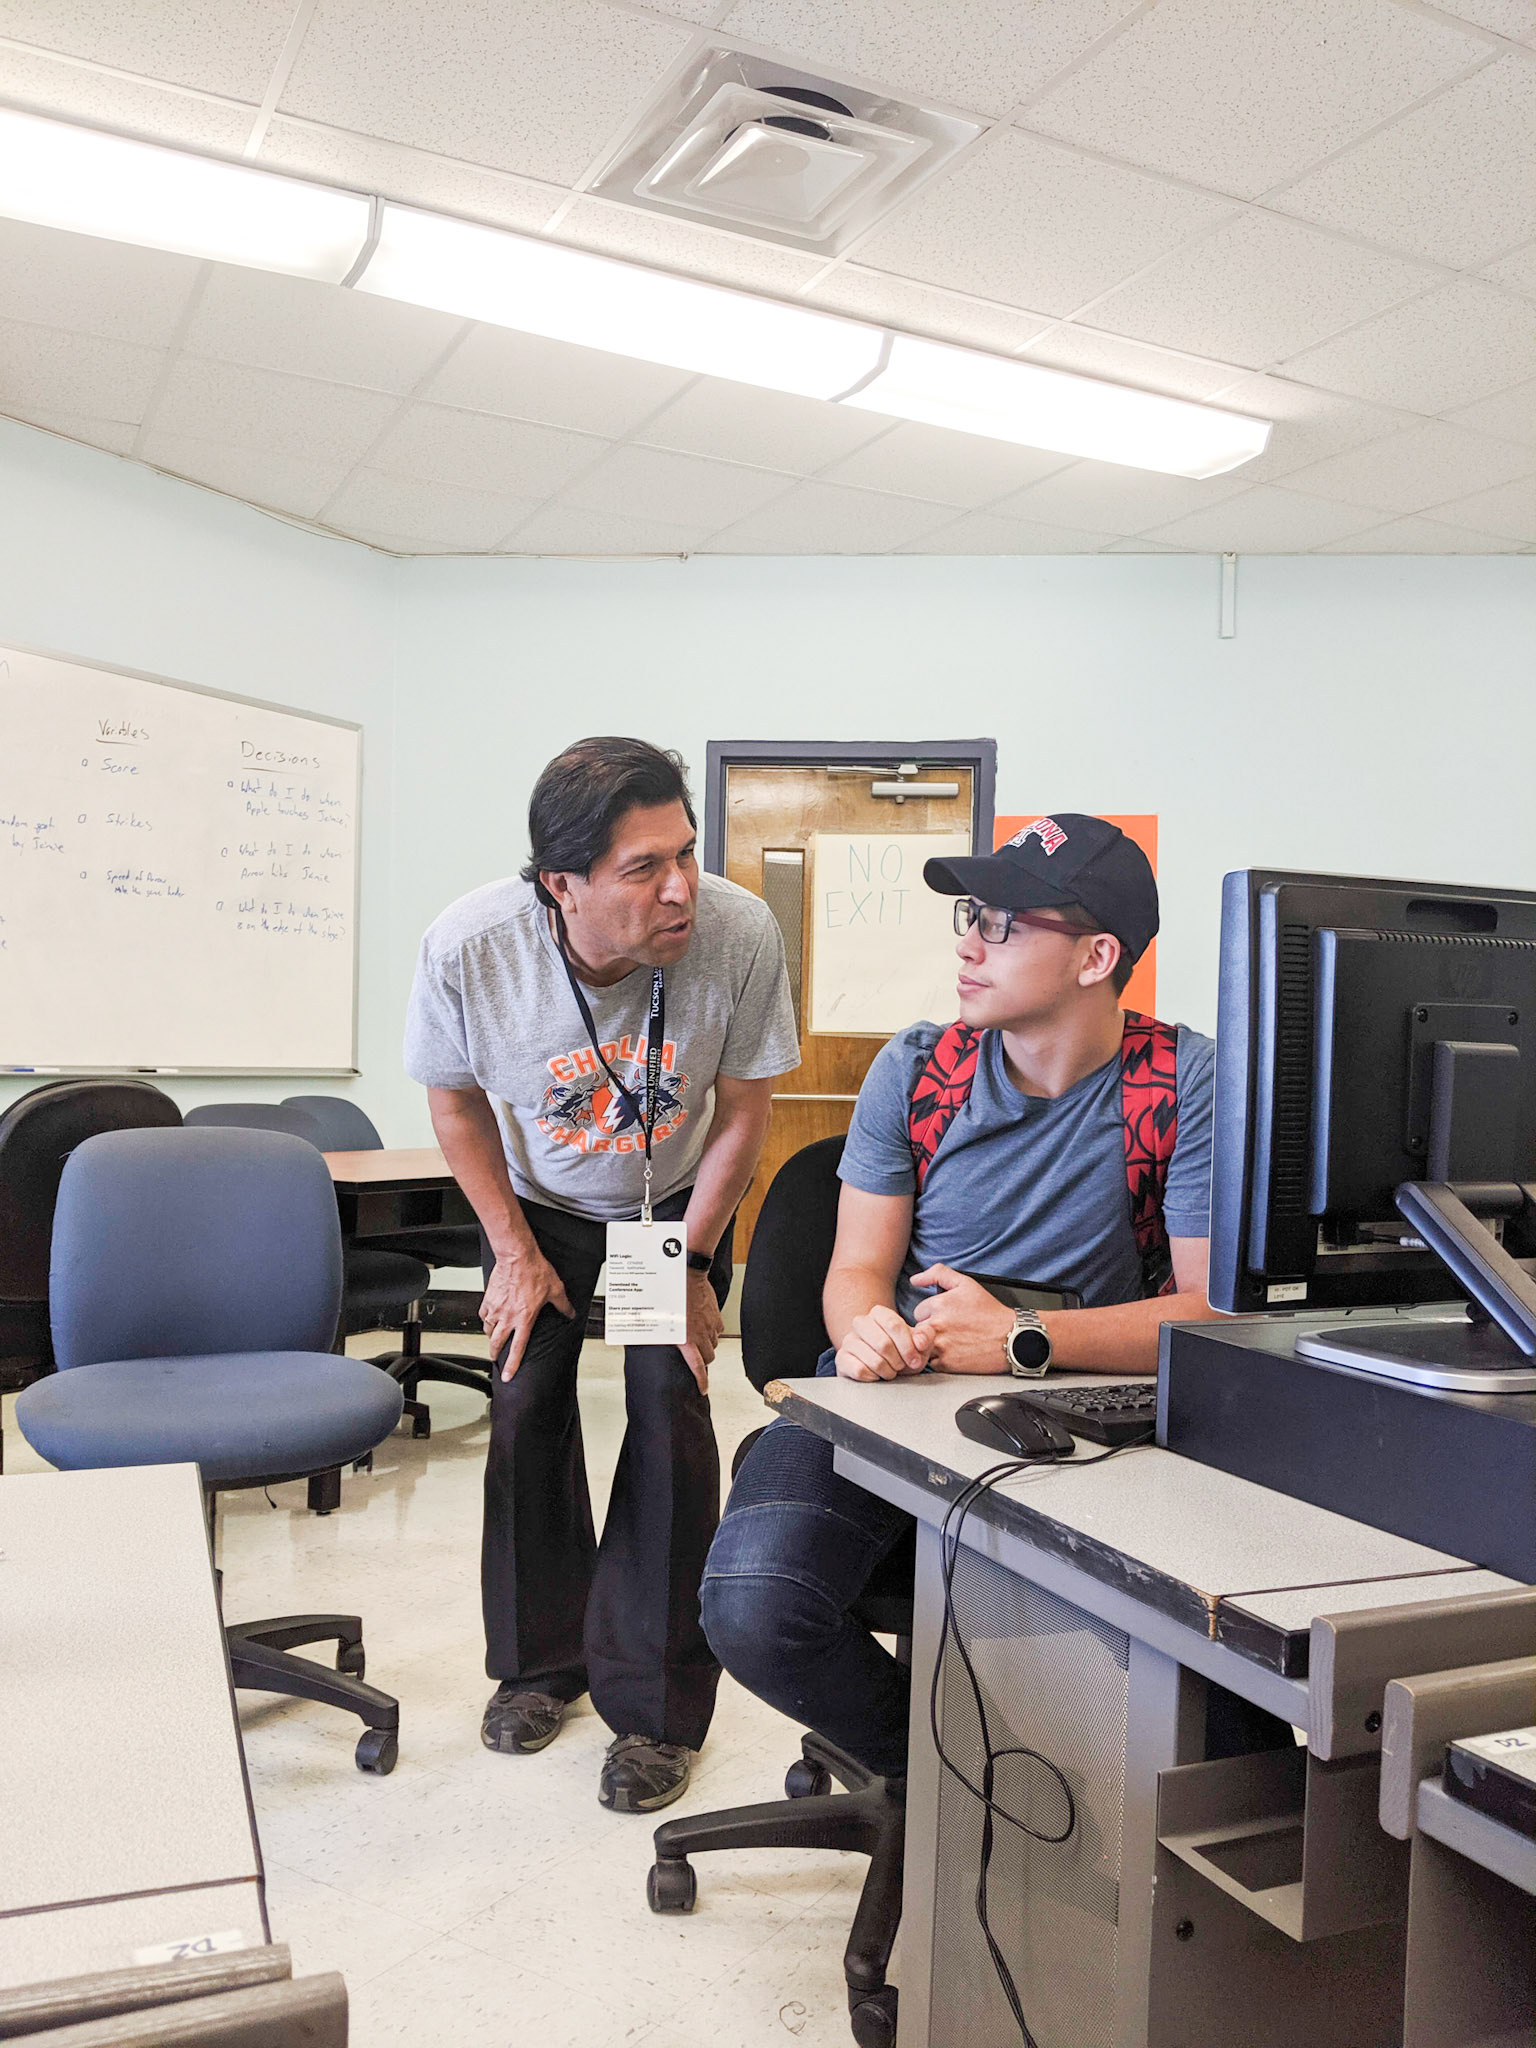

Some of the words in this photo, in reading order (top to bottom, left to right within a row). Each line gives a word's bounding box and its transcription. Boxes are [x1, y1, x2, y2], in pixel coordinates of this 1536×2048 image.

[98, 719, 150, 740] Variables
[241, 740, 320, 769] Decisions
[100, 757, 140, 775] Score
[241, 778, 262, 794] What
[269, 781, 278, 797] do
[285, 787, 295, 800] I
[301, 786, 310, 801] do
[320, 791, 341, 807] when
[246, 800, 271, 817] Apple
[278, 802, 309, 820] touches
[106, 812, 153, 832] Strikes
[12, 833, 24, 856] by
[239, 841, 260, 857] What
[285, 843, 294, 856] I
[320, 847, 342, 858] when
[241, 867, 265, 880] Arrow
[271, 861, 289, 878] hits
[849, 843, 902, 883] NO
[107, 869, 130, 885] Speed
[135, 870, 144, 881] of
[239, 897, 256, 913] What
[825, 889, 910, 928] EXIT
[650, 980, 660, 1020] TUCSON
[546, 1033, 678, 1083] CHOLLA
[648, 1046, 657, 1088] UNIFIED
